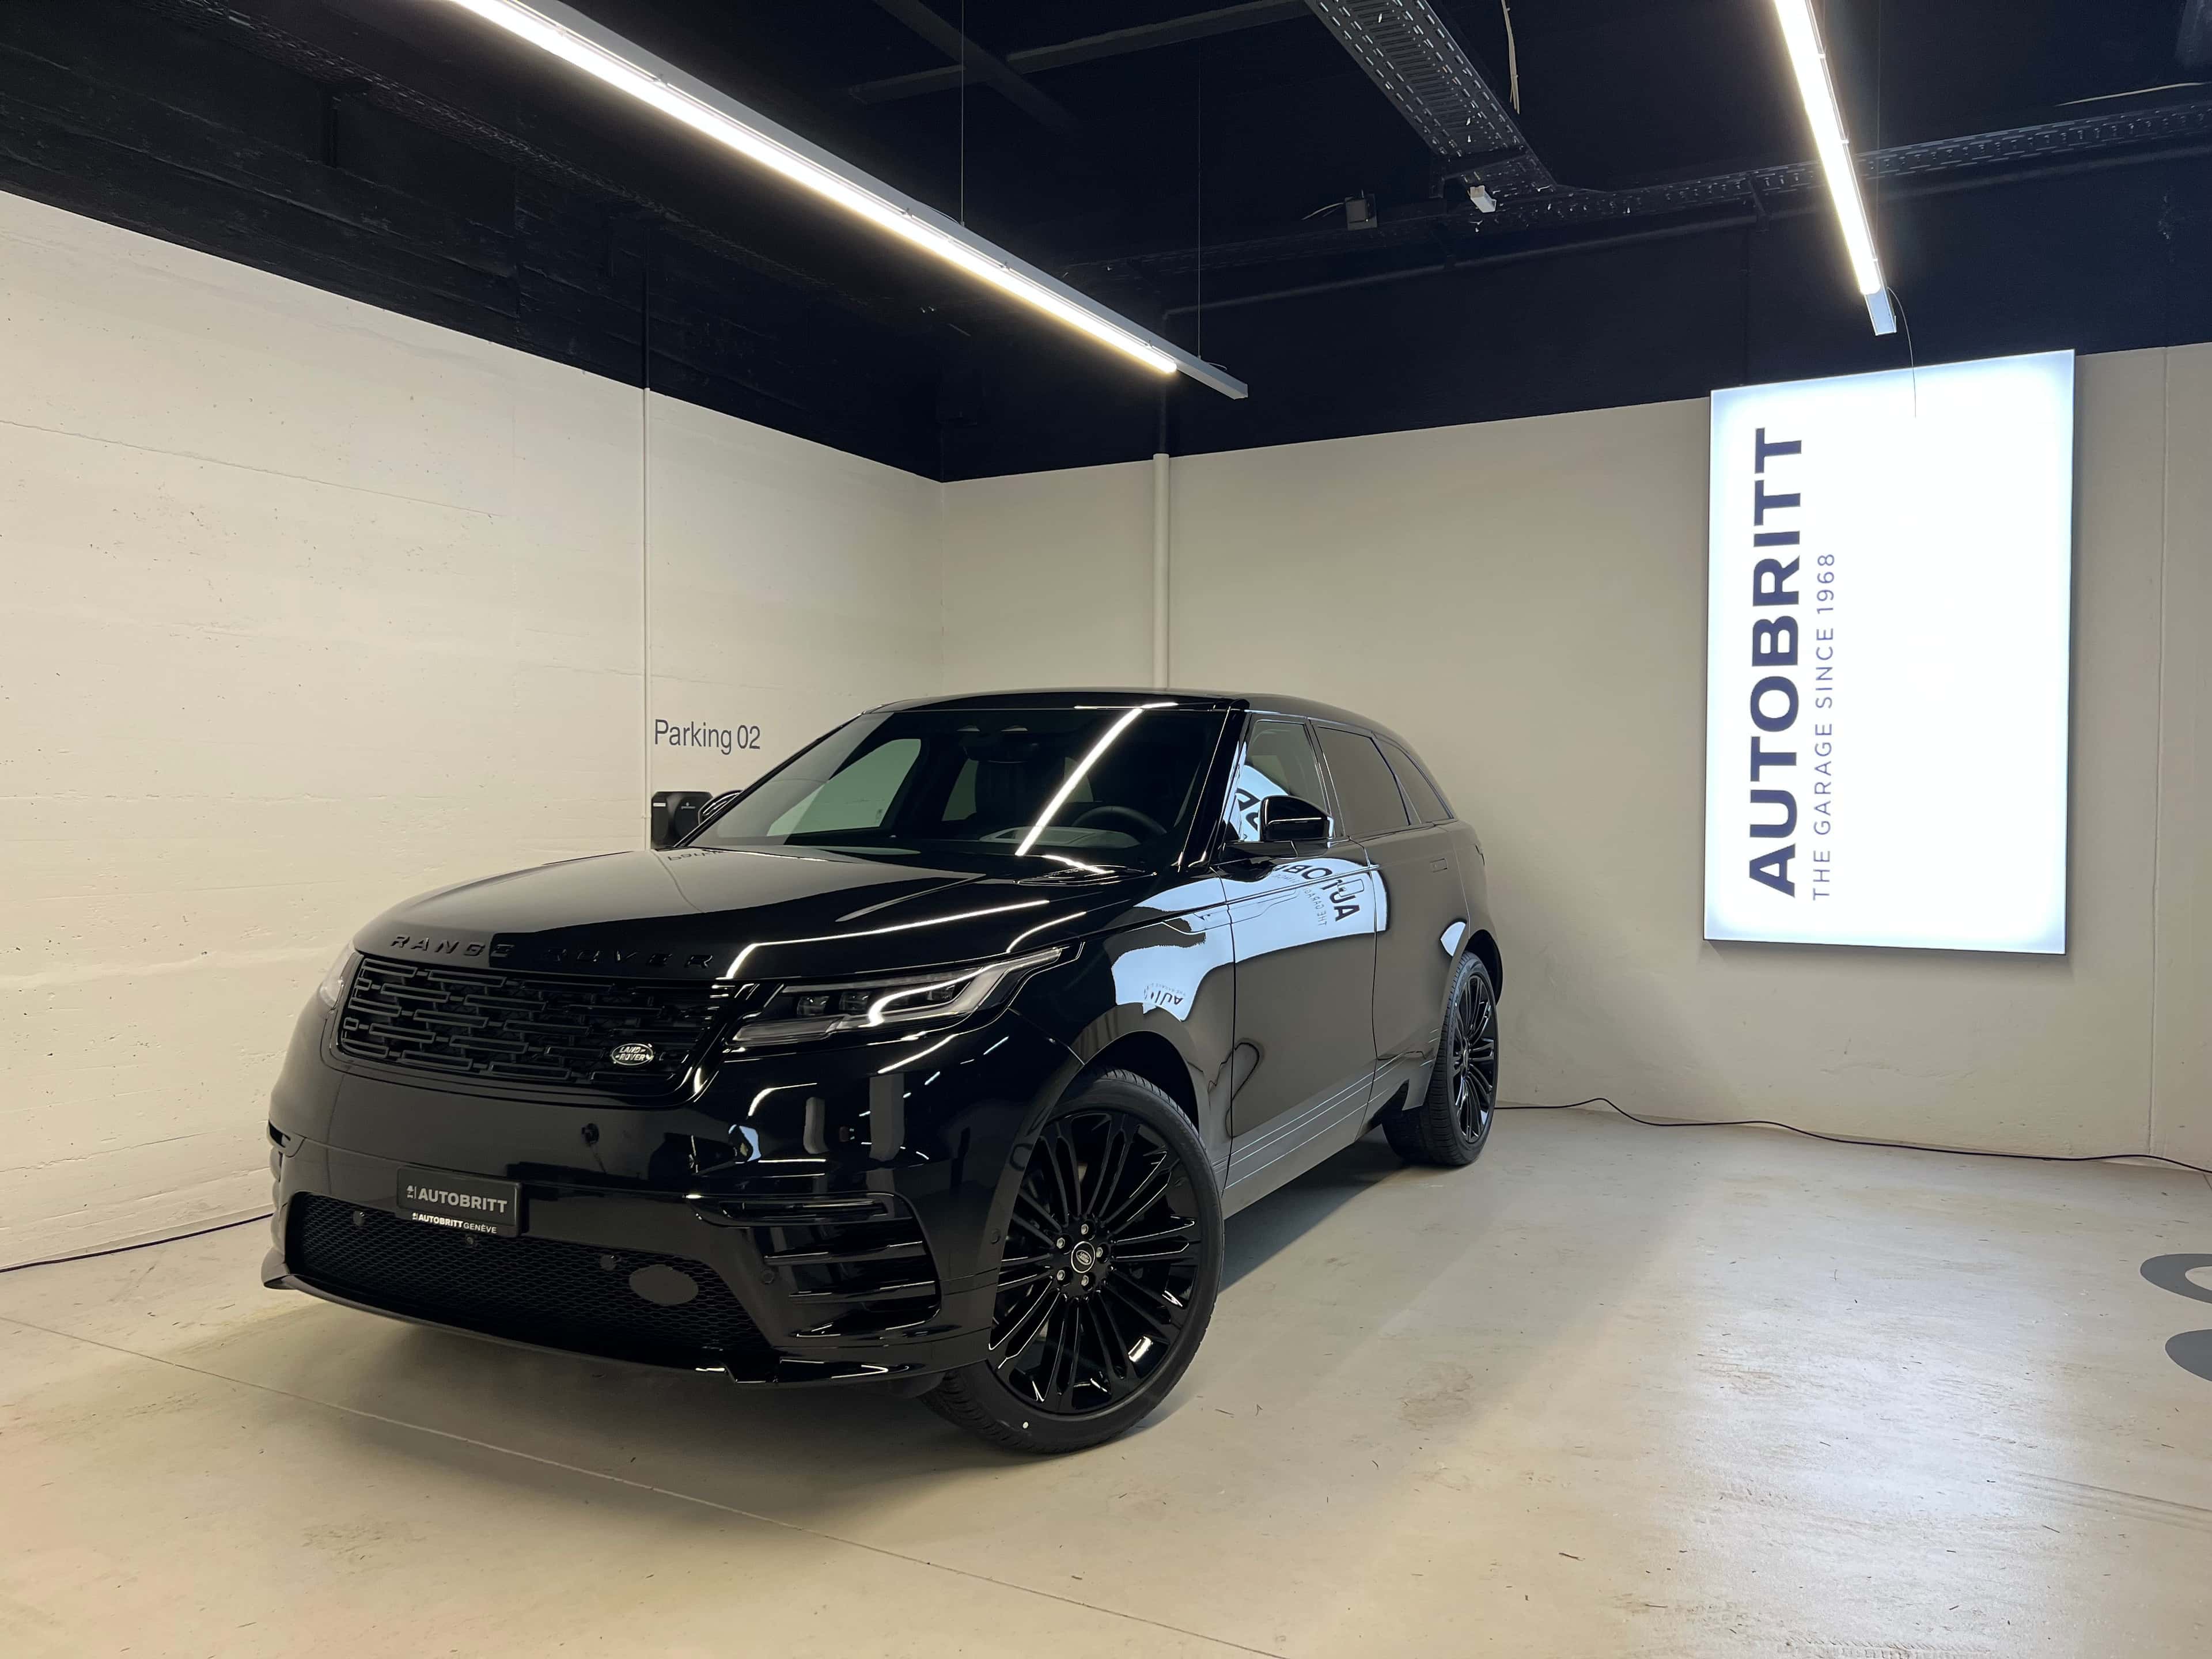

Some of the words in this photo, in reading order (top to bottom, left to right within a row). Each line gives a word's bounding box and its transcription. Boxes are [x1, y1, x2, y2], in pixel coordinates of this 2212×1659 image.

[1816, 554, 1835, 615] 1968
[1749, 427, 1802, 899] AUTOBRITT
[1815, 628, 1834, 709] SINCE
[655, 719, 732, 755] Parking
[737, 725, 760, 749] 02
[1813, 724, 1832, 835] GARAGE
[1812, 850, 1831, 900] THE
[391, 935, 515, 957] RANGE
[619, 1053, 645, 1061] ROVER
[418, 1187, 507, 1213] AUTOBRITT
[418, 1214, 463, 1228] AUTOBRITT
